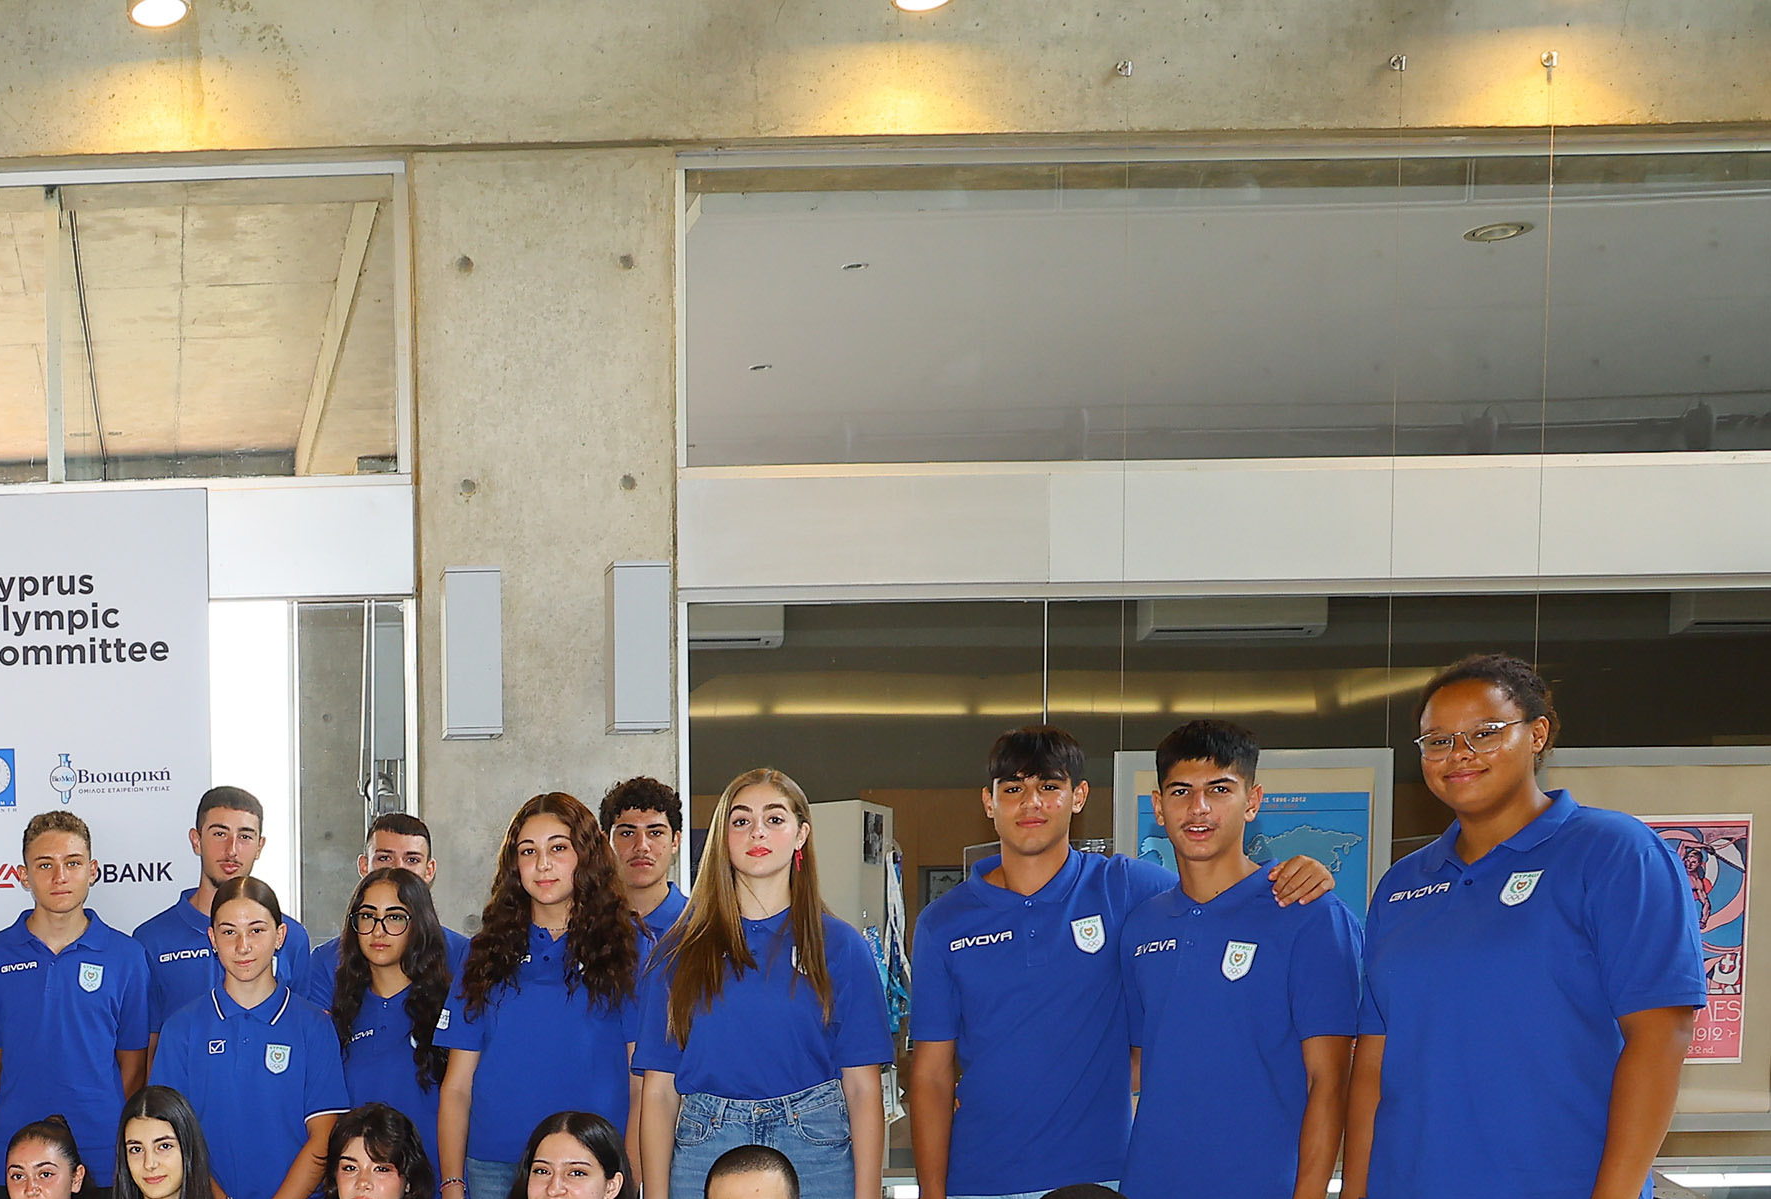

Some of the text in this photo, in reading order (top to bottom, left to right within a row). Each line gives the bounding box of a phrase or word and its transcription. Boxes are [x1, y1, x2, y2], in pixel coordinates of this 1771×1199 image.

[94, 862, 173, 883] BANK
[1388, 881, 1451, 903] GIVOVA
[948, 930, 1014, 952] GIVOVA
[159, 949, 210, 963] GIVOVA
[0, 961, 38, 974] GIVOVA
[1693, 1026, 1723, 1041] 1912
